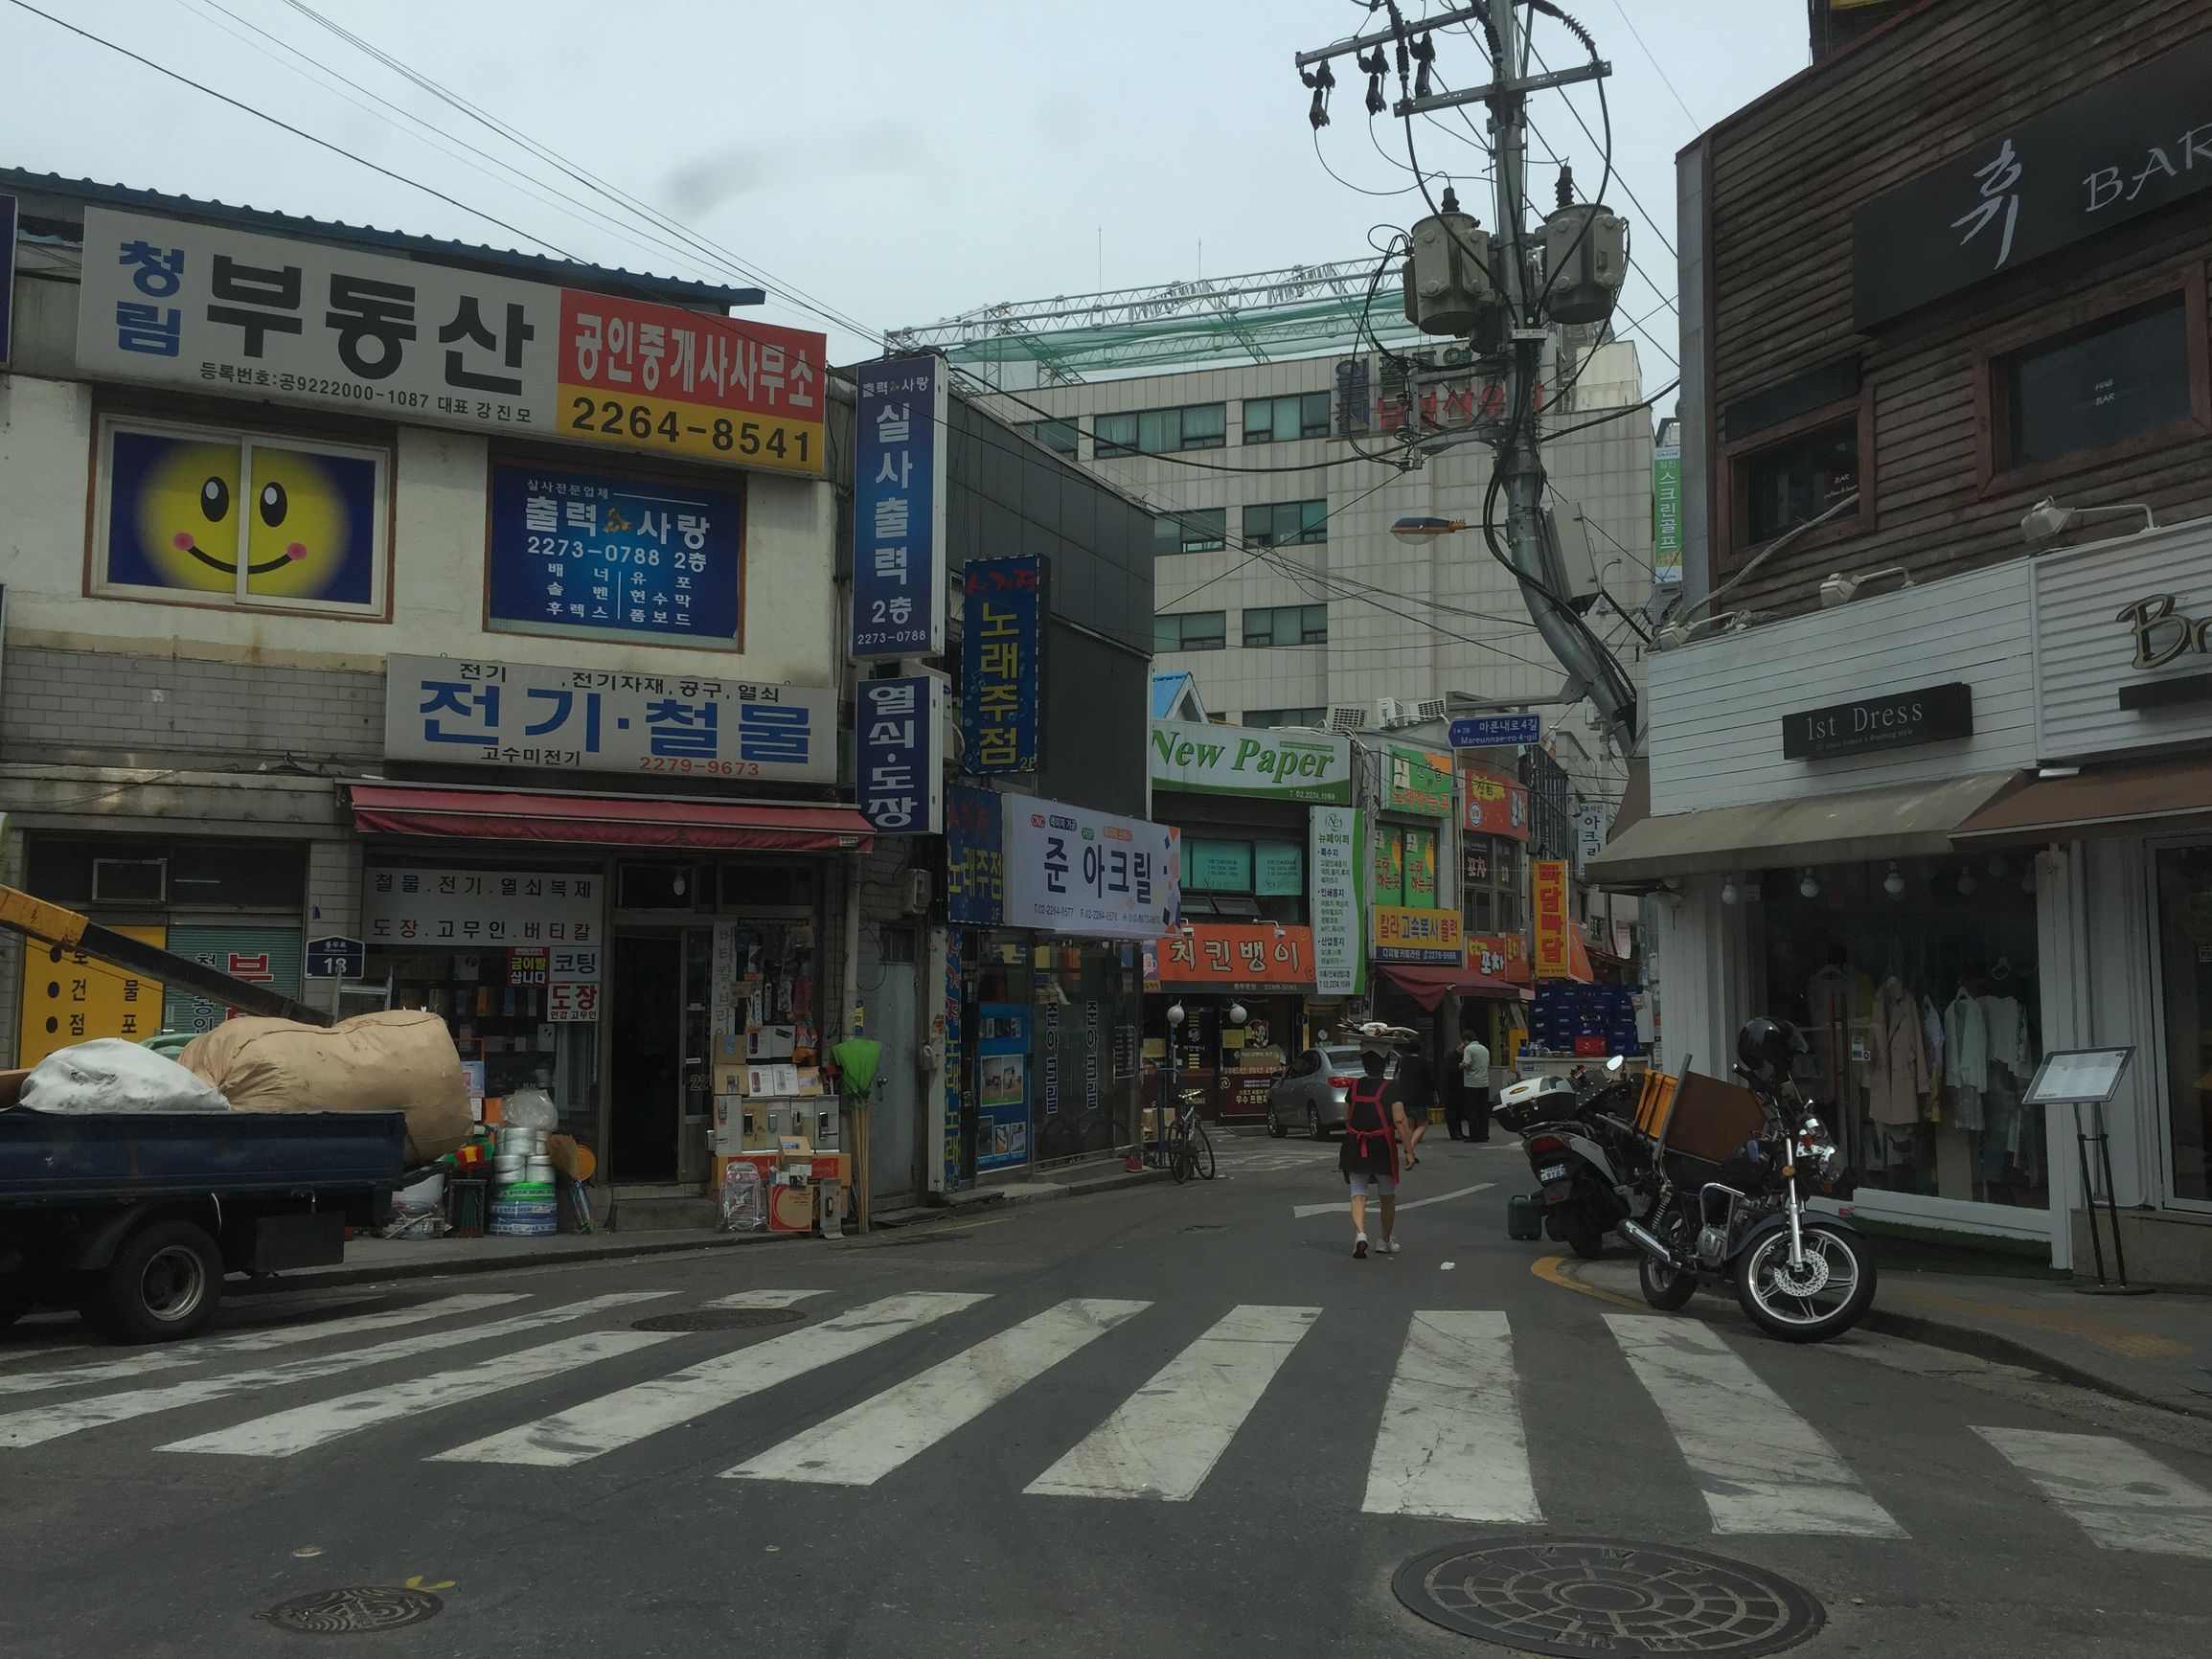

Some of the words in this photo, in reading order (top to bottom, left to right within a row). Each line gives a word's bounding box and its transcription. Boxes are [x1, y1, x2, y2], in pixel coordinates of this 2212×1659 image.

[117, 239, 185, 357] 청림
[206, 254, 535, 396] 부동산
[576, 312, 814, 408] 공인중개사사무소
[901, 375, 929, 393] 사랑
[438, 397, 469, 416] 대표
[477, 401, 533, 423] 강진모
[571, 396, 810, 463] 2264-8541
[526, 479, 609, 500] 실사전문업체
[875, 401, 914, 585] 실사출력
[526, 495, 598, 537] 출력
[637, 510, 712, 550] 사랑
[1659, 471, 1677, 549] 스크린골프
[528, 536, 661, 567] 2273-0788
[673, 551, 708, 574] 2층
[546, 601, 610, 619] 후렉스
[629, 608, 693, 626] 폼보드
[630, 590, 694, 609] 현수막
[871, 596, 913, 625] 2층
[857, 628, 927, 646] 2273-0788
[459, 663, 508, 683] 전기
[737, 682, 781, 704] 열쇠
[979, 601, 1021, 767] 노래주점
[1807, 716, 1837, 741] 1st
[1852, 702, 1924, 735] Dress
[480, 745, 582, 767] 고수미전기
[639, 756, 761, 778] 2279-9673
[1152, 728, 1226, 769] New
[1230, 737, 1335, 784] Paper
[1044, 837, 1069, 894] 준
[1083, 845, 1152, 905] 아크릴
[554, 954, 597, 975] 코팅
[1169, 938, 1300, 974] 치킨뱅이
[551, 985, 599, 1011] 도장
